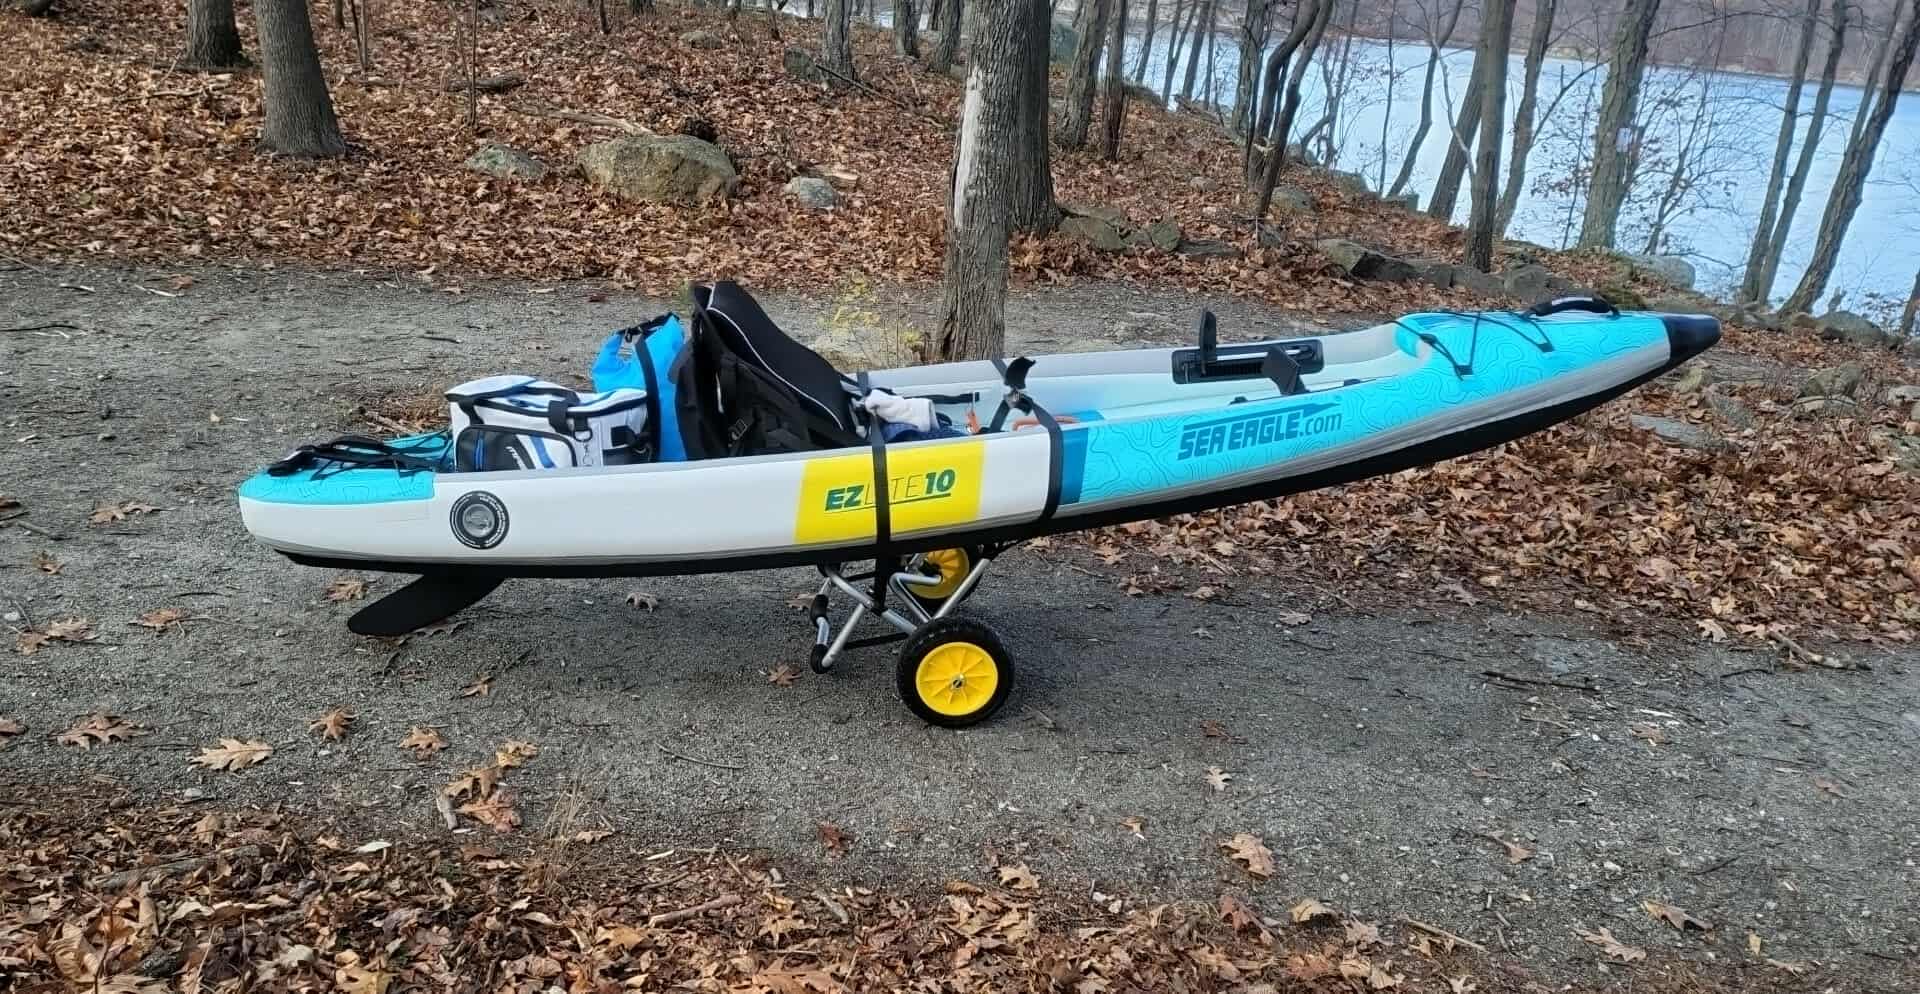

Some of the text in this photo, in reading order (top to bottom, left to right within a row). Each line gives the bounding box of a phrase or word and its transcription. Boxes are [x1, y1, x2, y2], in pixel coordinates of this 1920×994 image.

[1177, 410, 1342, 460] SEA EAGLE.com
[825, 469, 956, 511] EZLTE10
